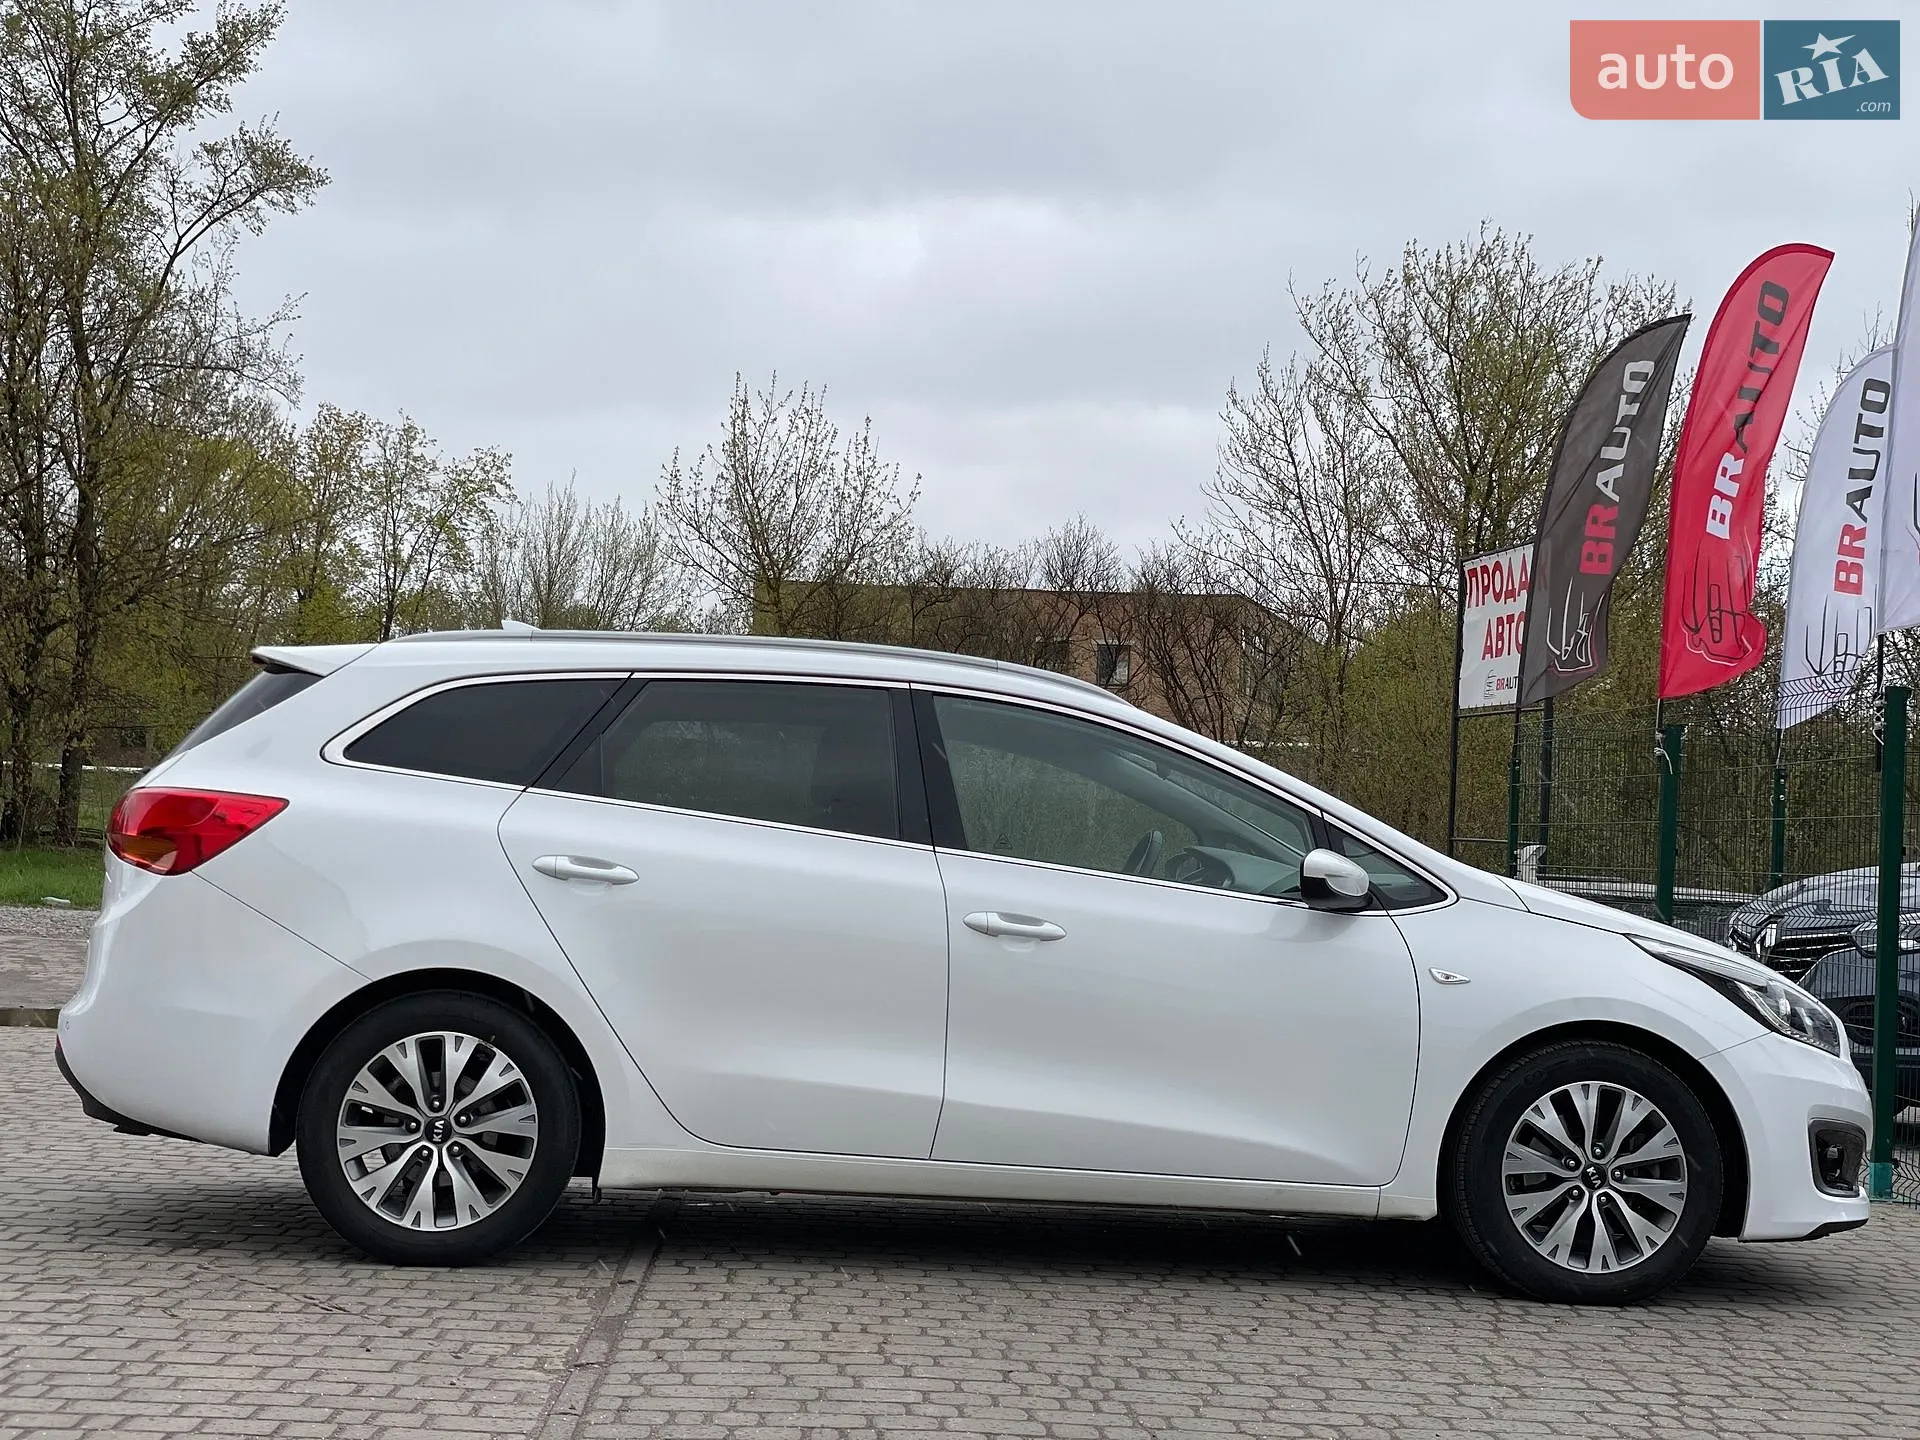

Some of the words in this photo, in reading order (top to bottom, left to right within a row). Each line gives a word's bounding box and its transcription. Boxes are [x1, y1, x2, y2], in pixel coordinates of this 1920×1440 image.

[1578, 360, 1655, 575] BRAUTO
[1706, 280, 1790, 540] BRAUTO
[1833, 378, 1892, 596] BRAUTO
[1467, 552, 1530, 609] ПРОДА
[1496, 675, 1519, 691] BRAUT
